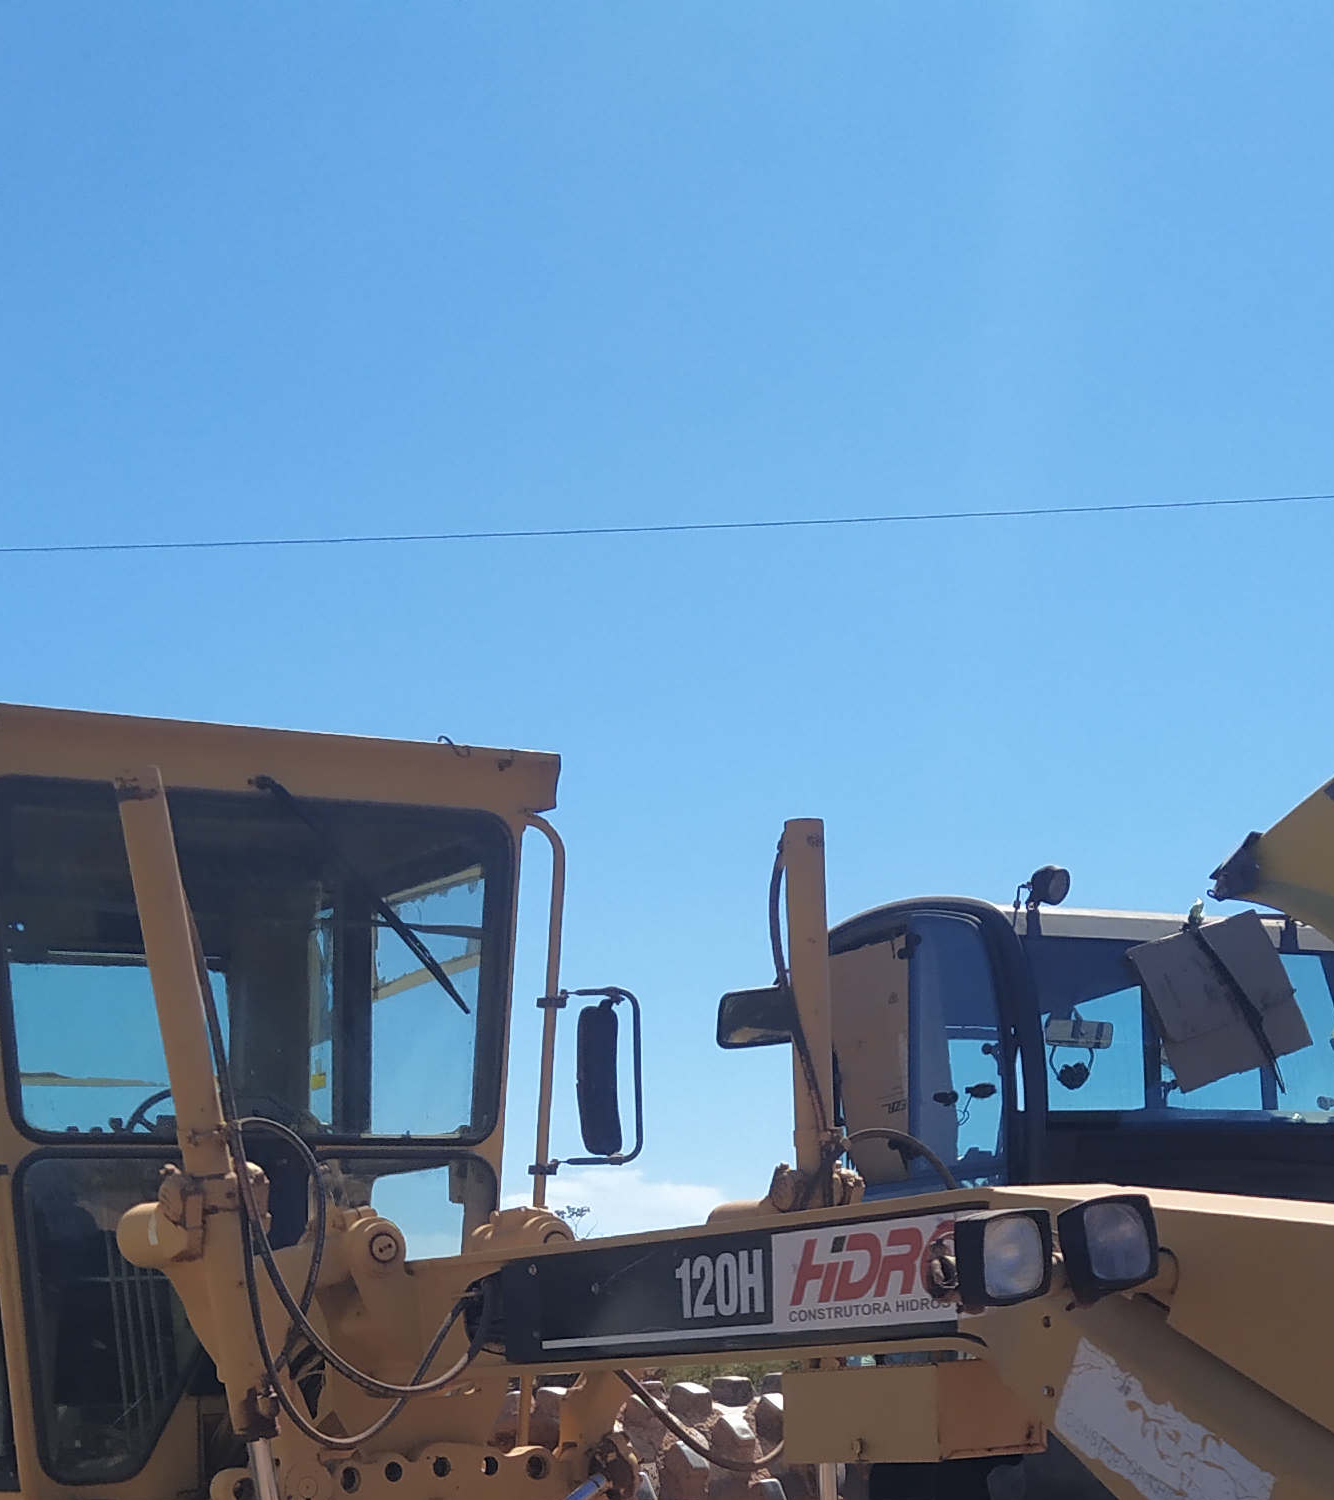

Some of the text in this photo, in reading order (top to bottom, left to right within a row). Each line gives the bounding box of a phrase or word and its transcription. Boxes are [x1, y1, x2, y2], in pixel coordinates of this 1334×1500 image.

[674, 1248, 765, 1319] 120H
[788, 1297, 952, 1324] CONSTRUTORA HIDROS
